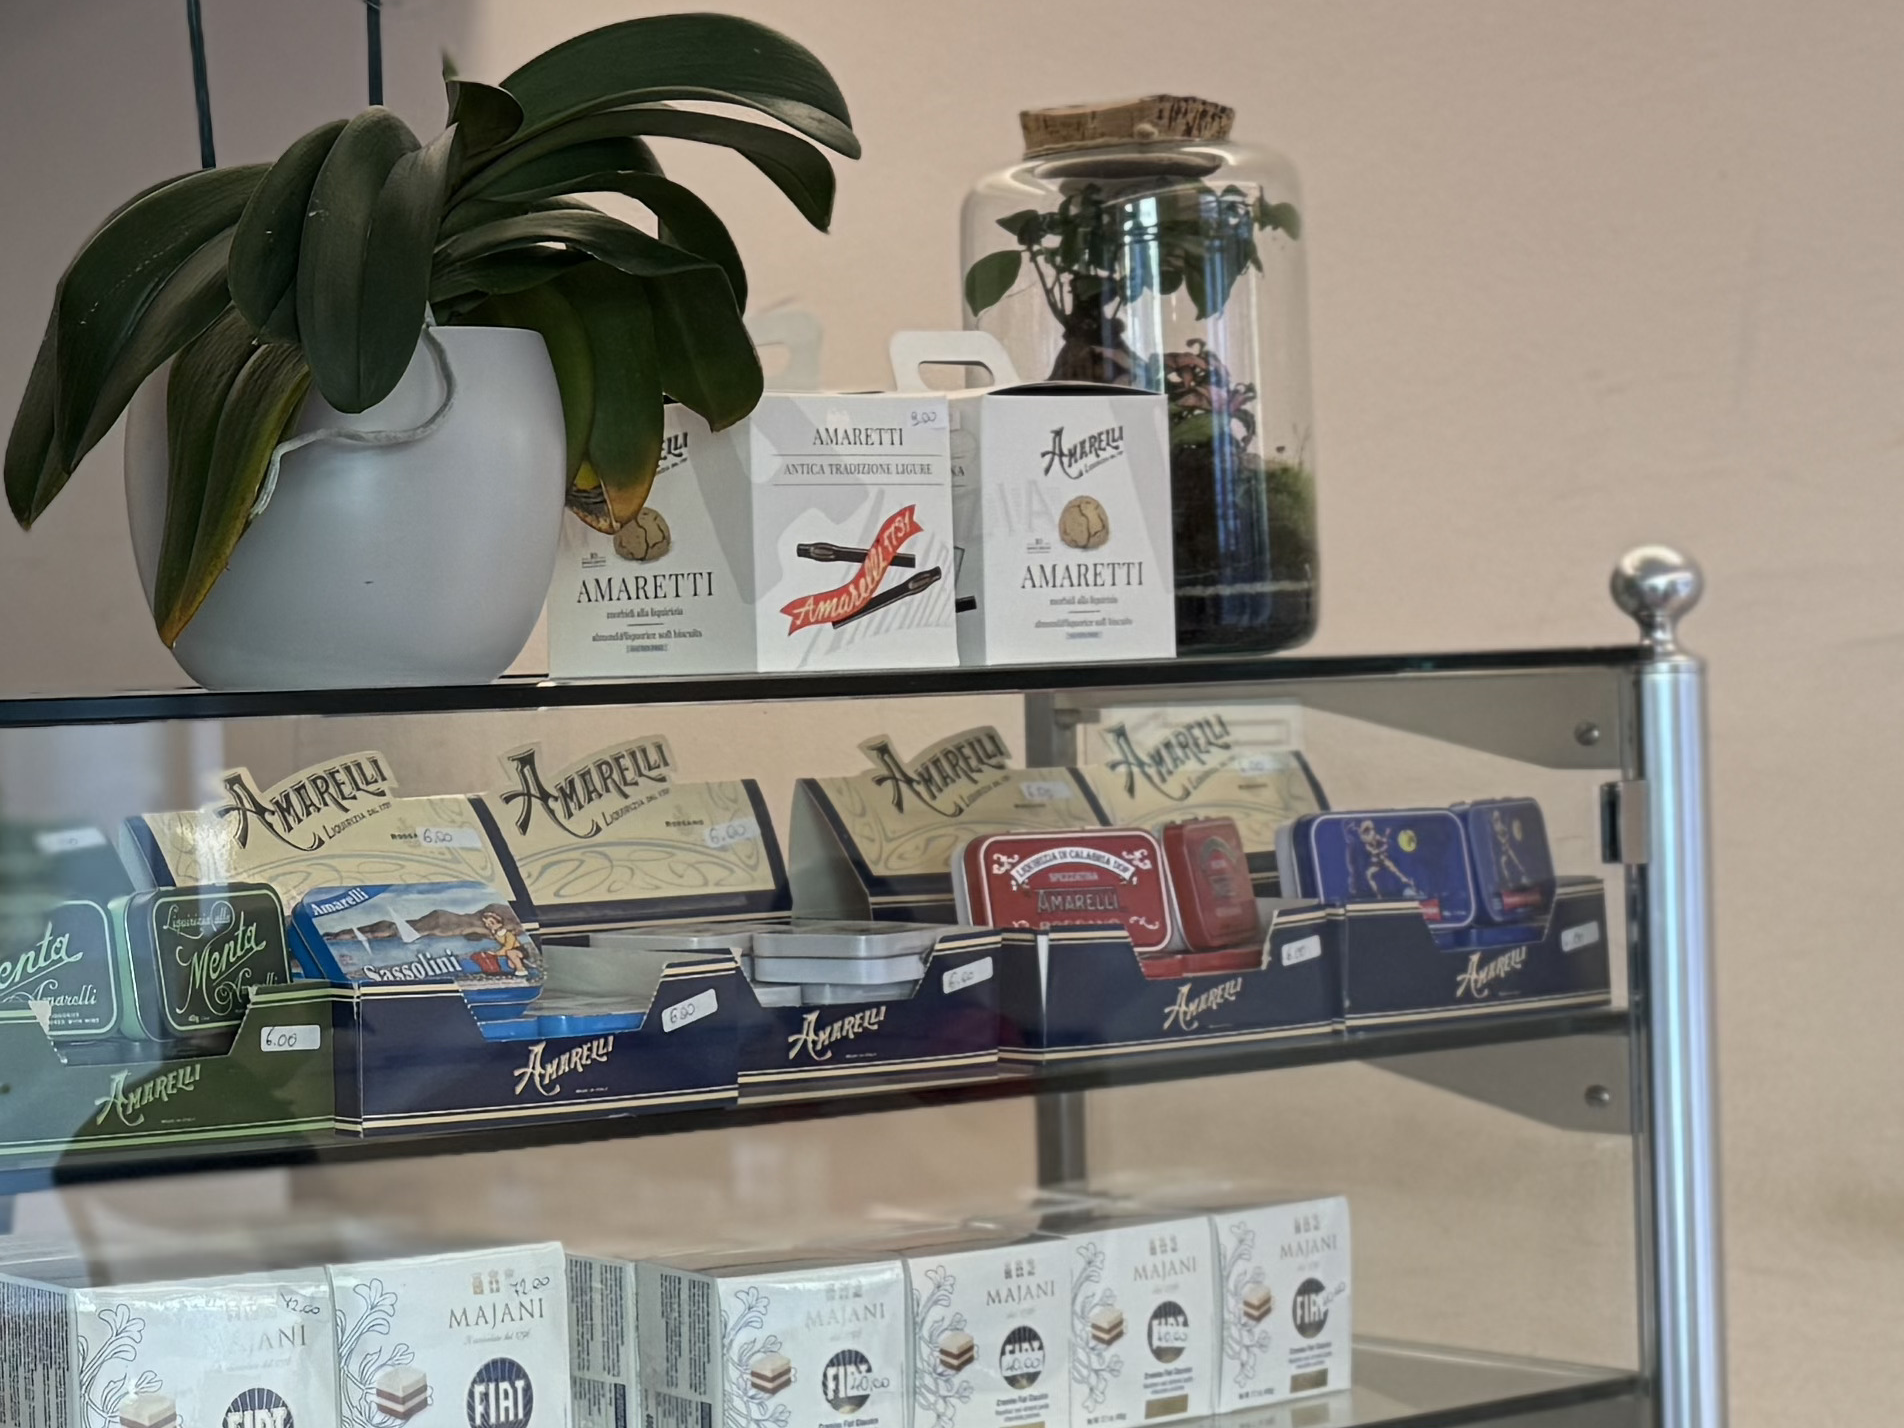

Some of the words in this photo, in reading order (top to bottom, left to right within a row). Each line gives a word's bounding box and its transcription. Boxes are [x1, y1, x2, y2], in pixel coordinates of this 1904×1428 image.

[812, 428, 904, 447] AMARETTI
[784, 463, 826, 475] ANTICA
[828, 463, 893, 475] TRADIZIONE
[895, 463, 932, 475] LIGURE
[576, 571, 714, 604] AMARETTI
[1021, 562, 1144, 589] AMARETTI
[311, 886, 370, 920] Amarelli
[362, 949, 463, 982] Sassolini
[265, 1027, 298, 1048] 6.00
[1280, 1234, 1337, 1260] MAJANI
[1133, 1256, 1197, 1282] MAJANI
[986, 1281, 1055, 1306] MAJANI
[448, 1297, 544, 1329] MAJANI
[805, 1303, 886, 1329] MAJANI
[474, 1379, 525, 1426] FIAT
